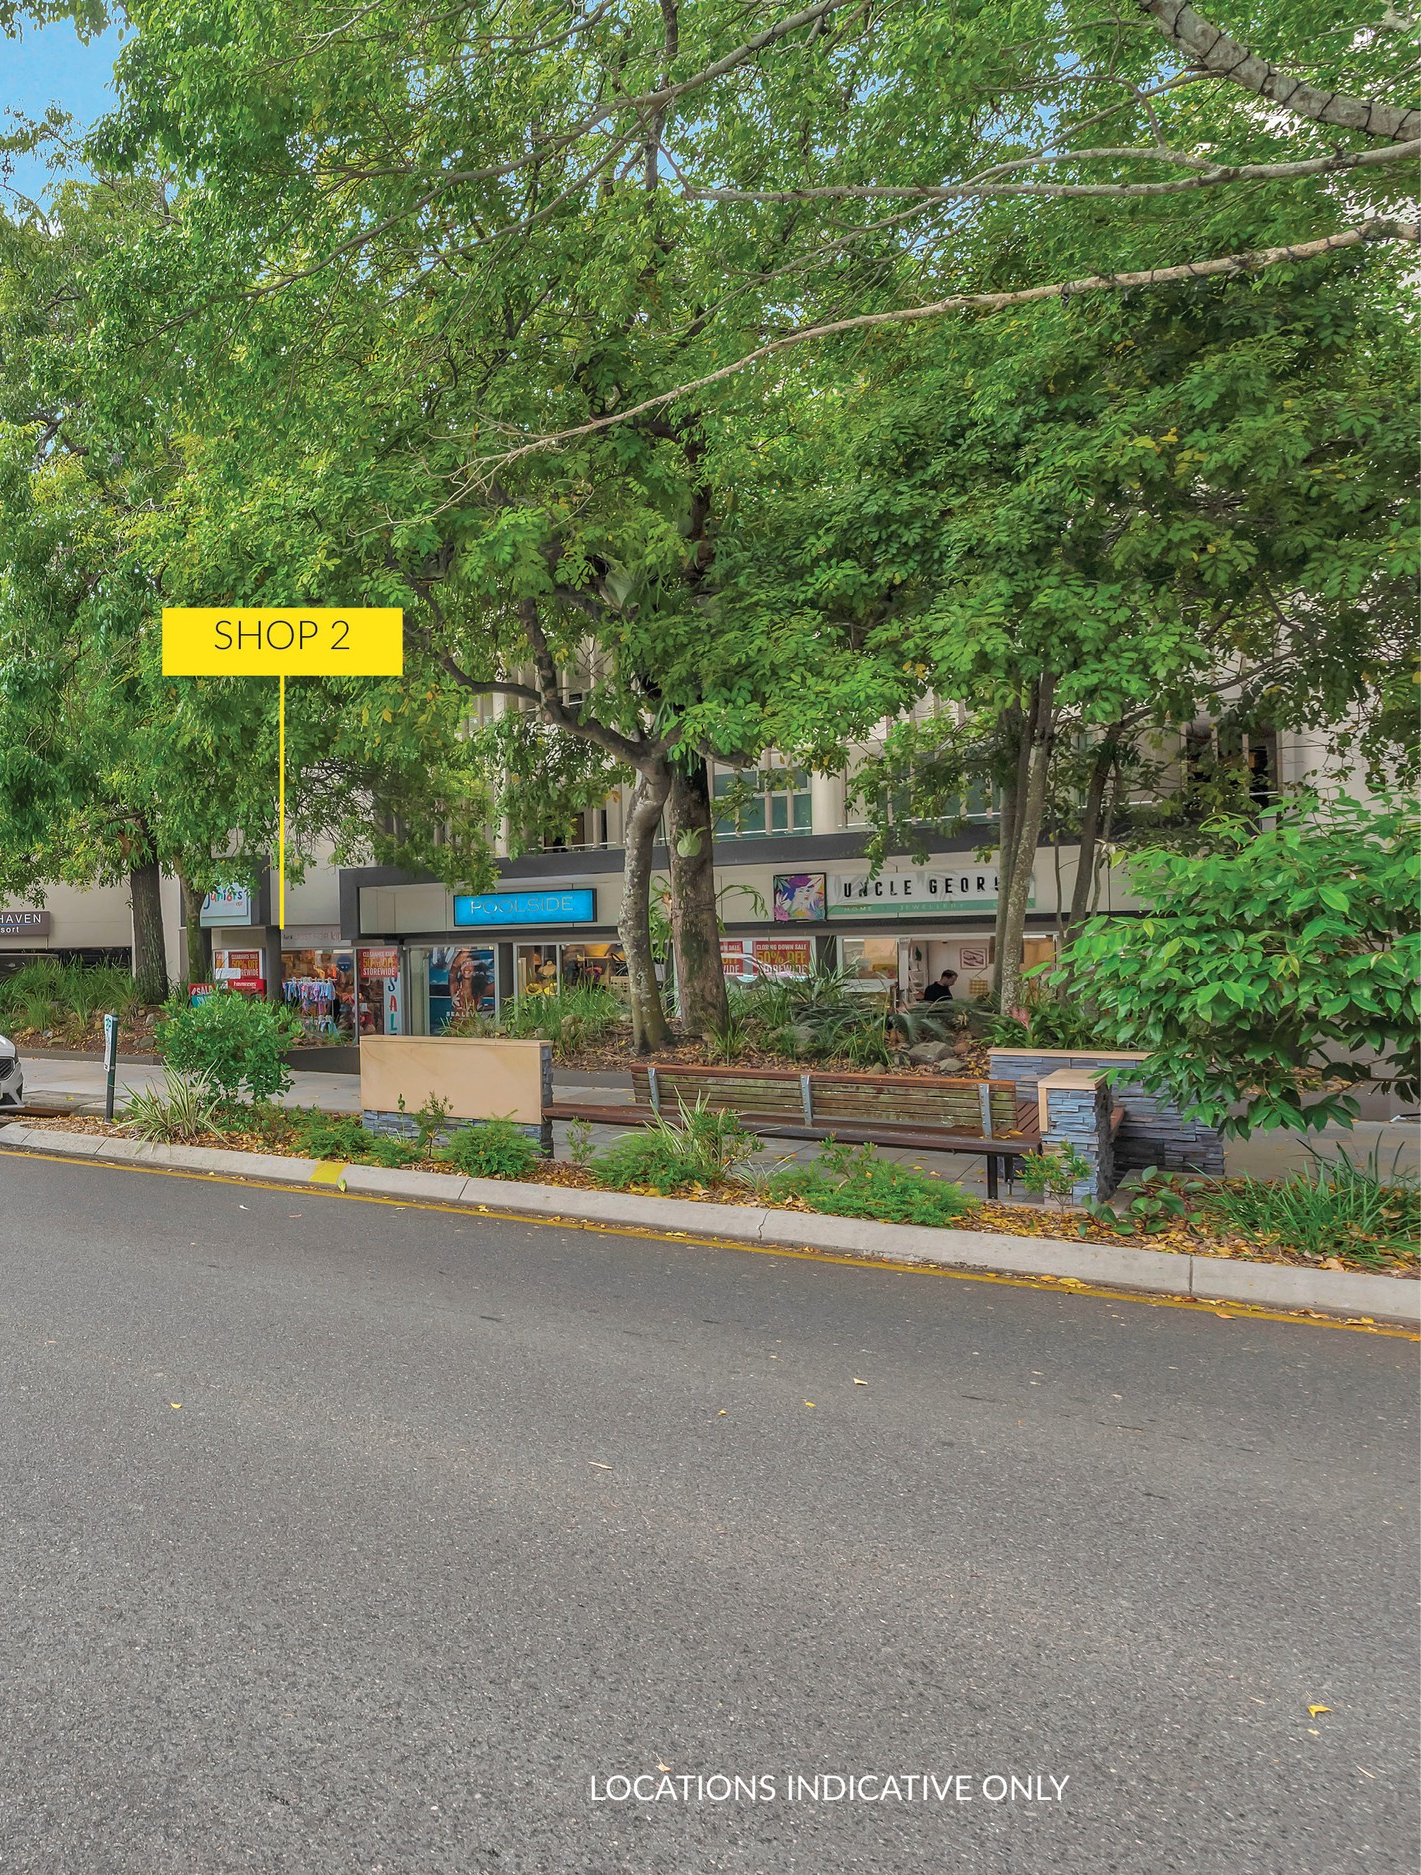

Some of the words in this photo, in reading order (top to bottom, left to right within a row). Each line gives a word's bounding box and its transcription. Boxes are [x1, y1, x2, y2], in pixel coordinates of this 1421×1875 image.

[843, 879, 912, 898] UNCLE
[203, 889, 243, 910] Juniors
[470, 896, 574, 915] POOLSIDE
[899, 902, 965, 911] JEWELLERY
[363, 957, 381, 969] 50%
[382, 957, 395, 968] OFF
[756, 951, 784, 964] 50%
[786, 950, 807, 964] OFF
[231, 960, 247, 969] 50%
[248, 960, 259, 969] OFF
[363, 967, 395, 976] STOREWIDE
[387, 976, 398, 1035] SAL
